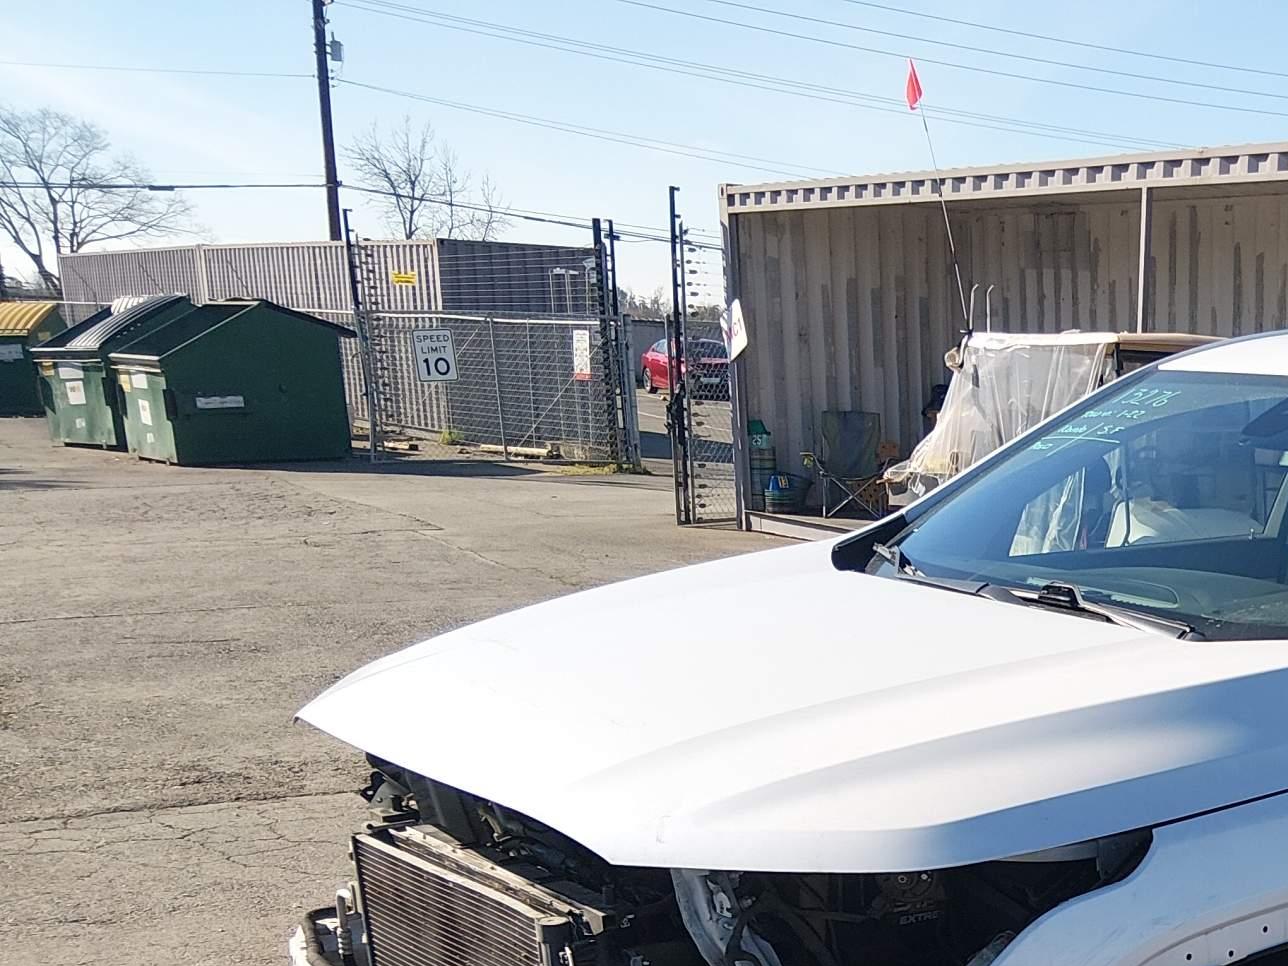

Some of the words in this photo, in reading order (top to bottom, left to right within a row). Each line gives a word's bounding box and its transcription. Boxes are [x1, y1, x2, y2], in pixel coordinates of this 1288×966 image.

[416, 334, 449, 343] SPEED
[421, 346, 447, 354] LIMIT
[423, 357, 450, 376] 10
